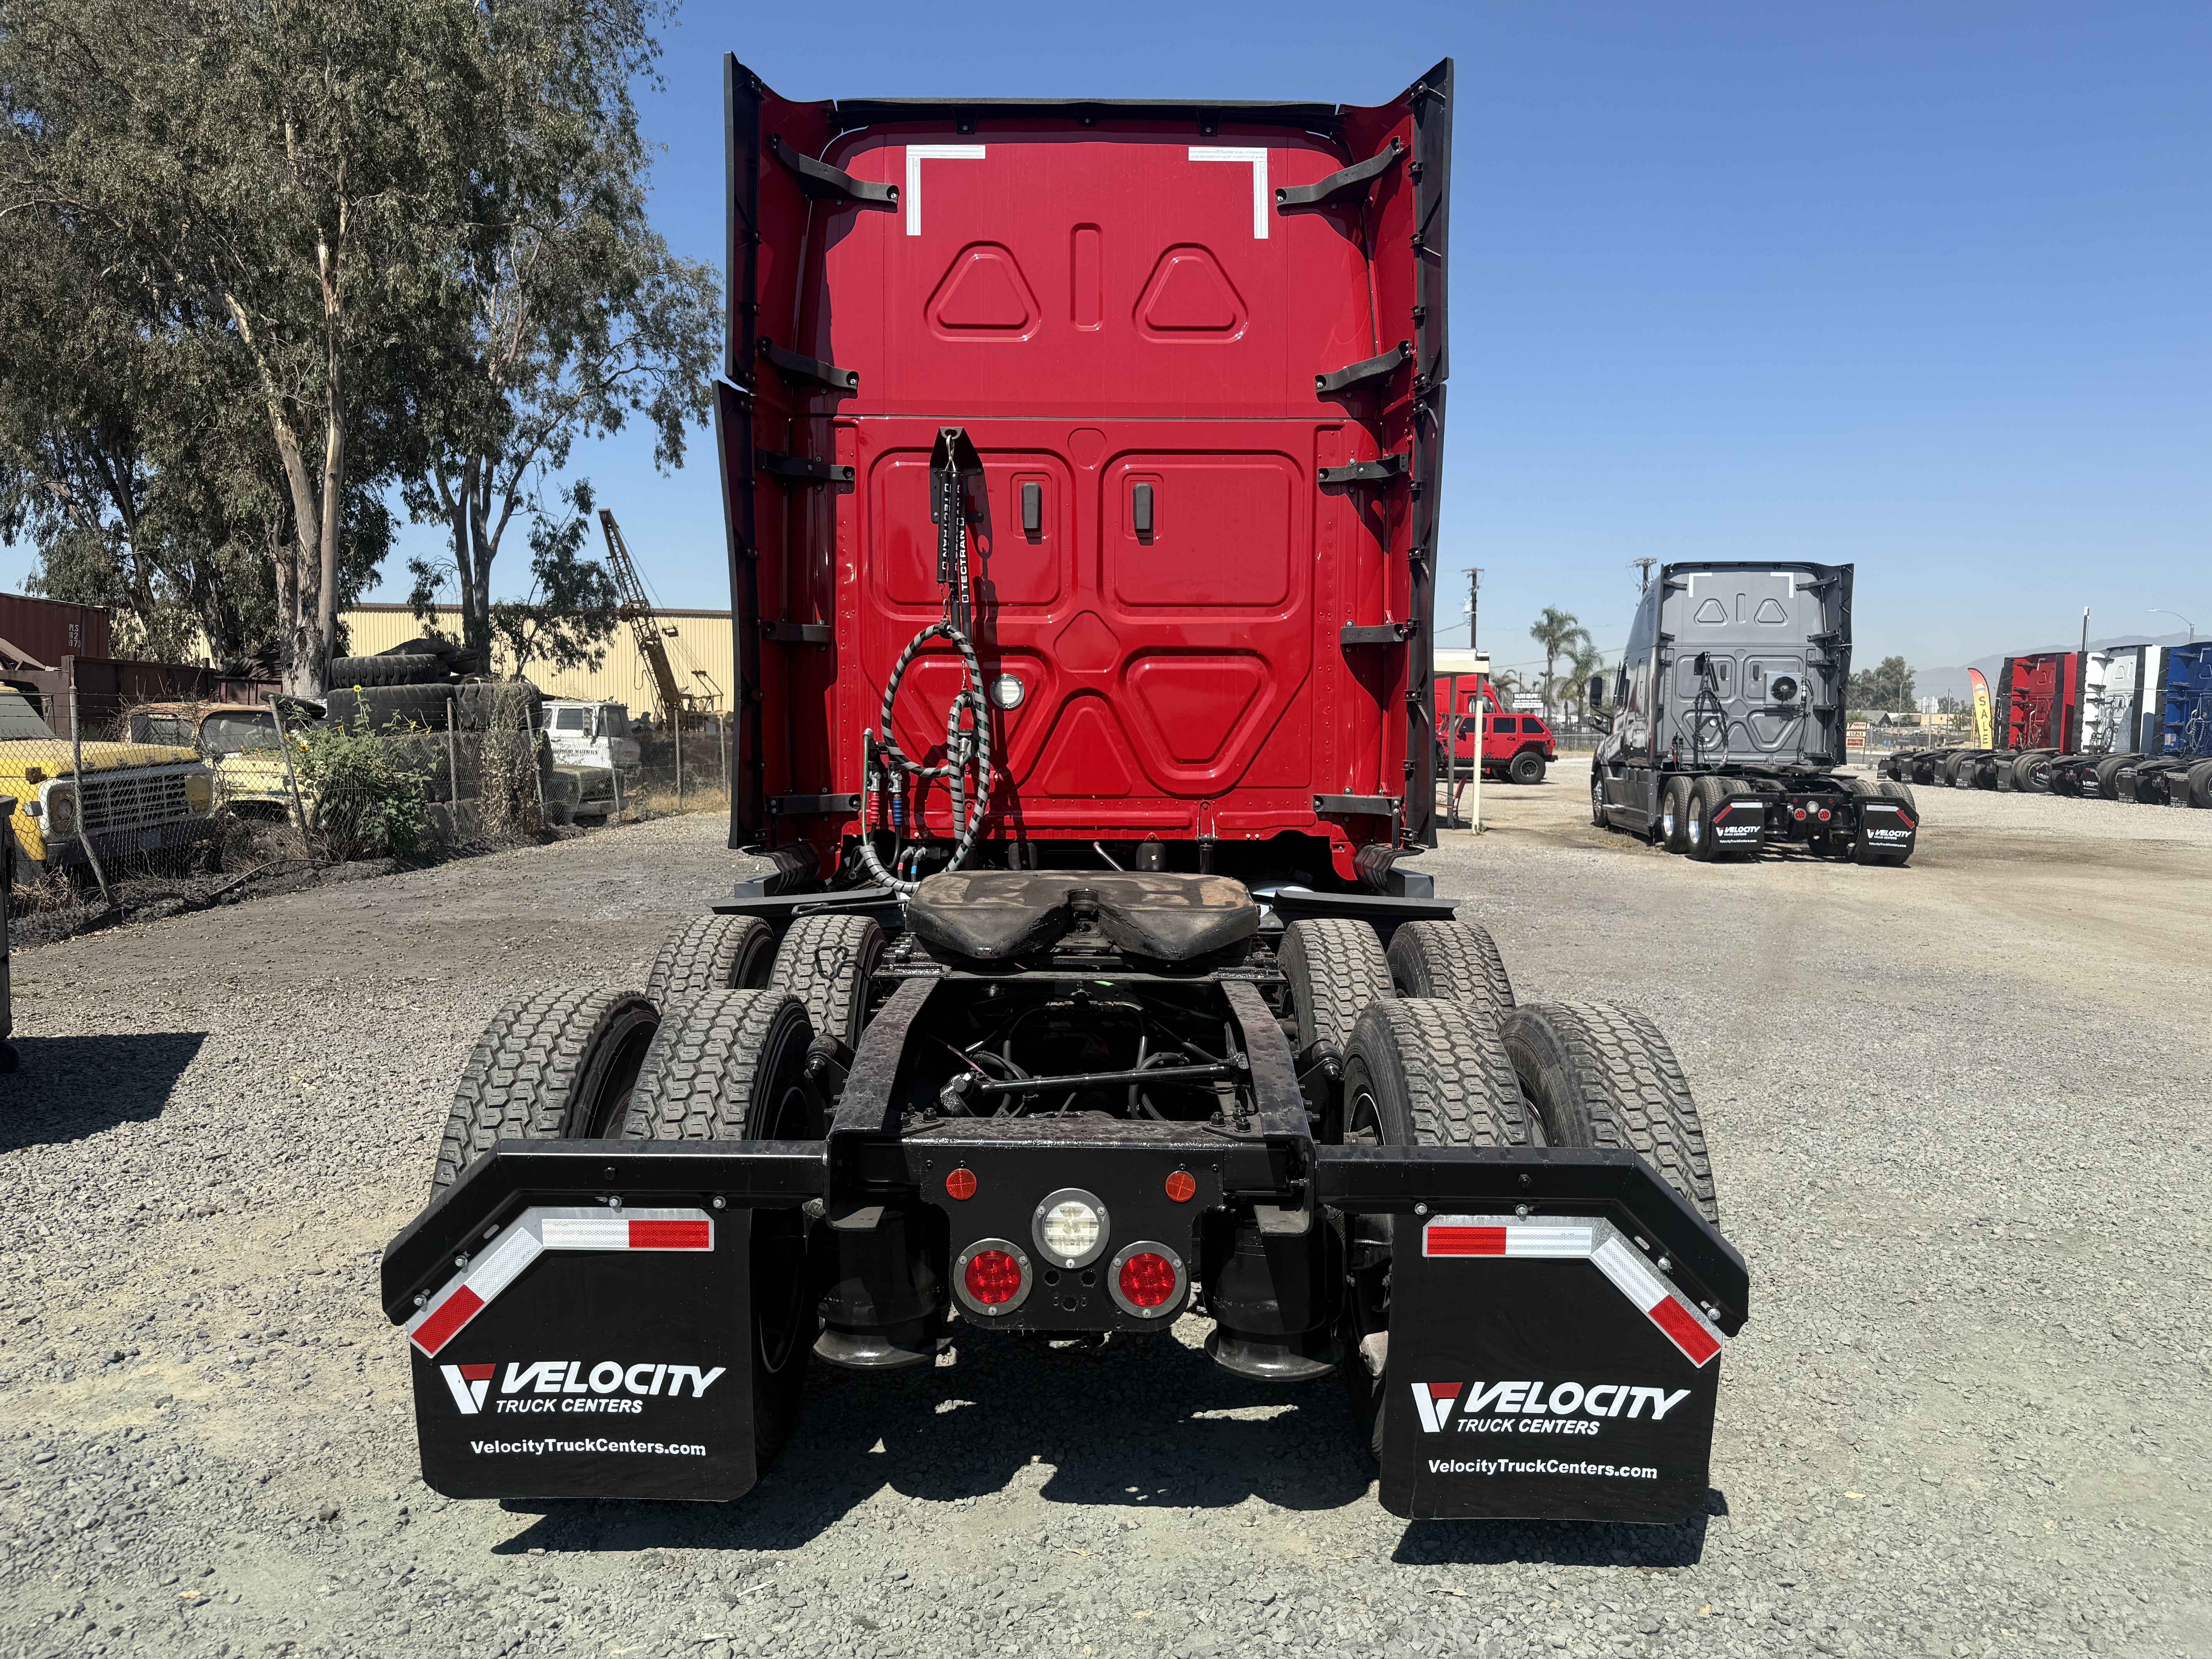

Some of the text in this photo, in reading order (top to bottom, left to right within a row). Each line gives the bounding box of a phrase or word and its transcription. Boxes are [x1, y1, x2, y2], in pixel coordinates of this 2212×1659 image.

[959, 530, 968, 591] TECTRAN
[1979, 696, 1988, 744] SALE
[1875, 829, 1912, 838] VELOCITY
[501, 1361, 726, 1397] VELOCITY
[496, 1398, 643, 1413] TRUCK CENTERS
[1464, 1381, 1691, 1420] VELOCITY
[1457, 1419, 1600, 1435] TRUCK CENTERS
[471, 1438, 706, 1456] VelocityTruckCenters.com
[1428, 1459, 1657, 1479] VelocityTruckCenters.com
